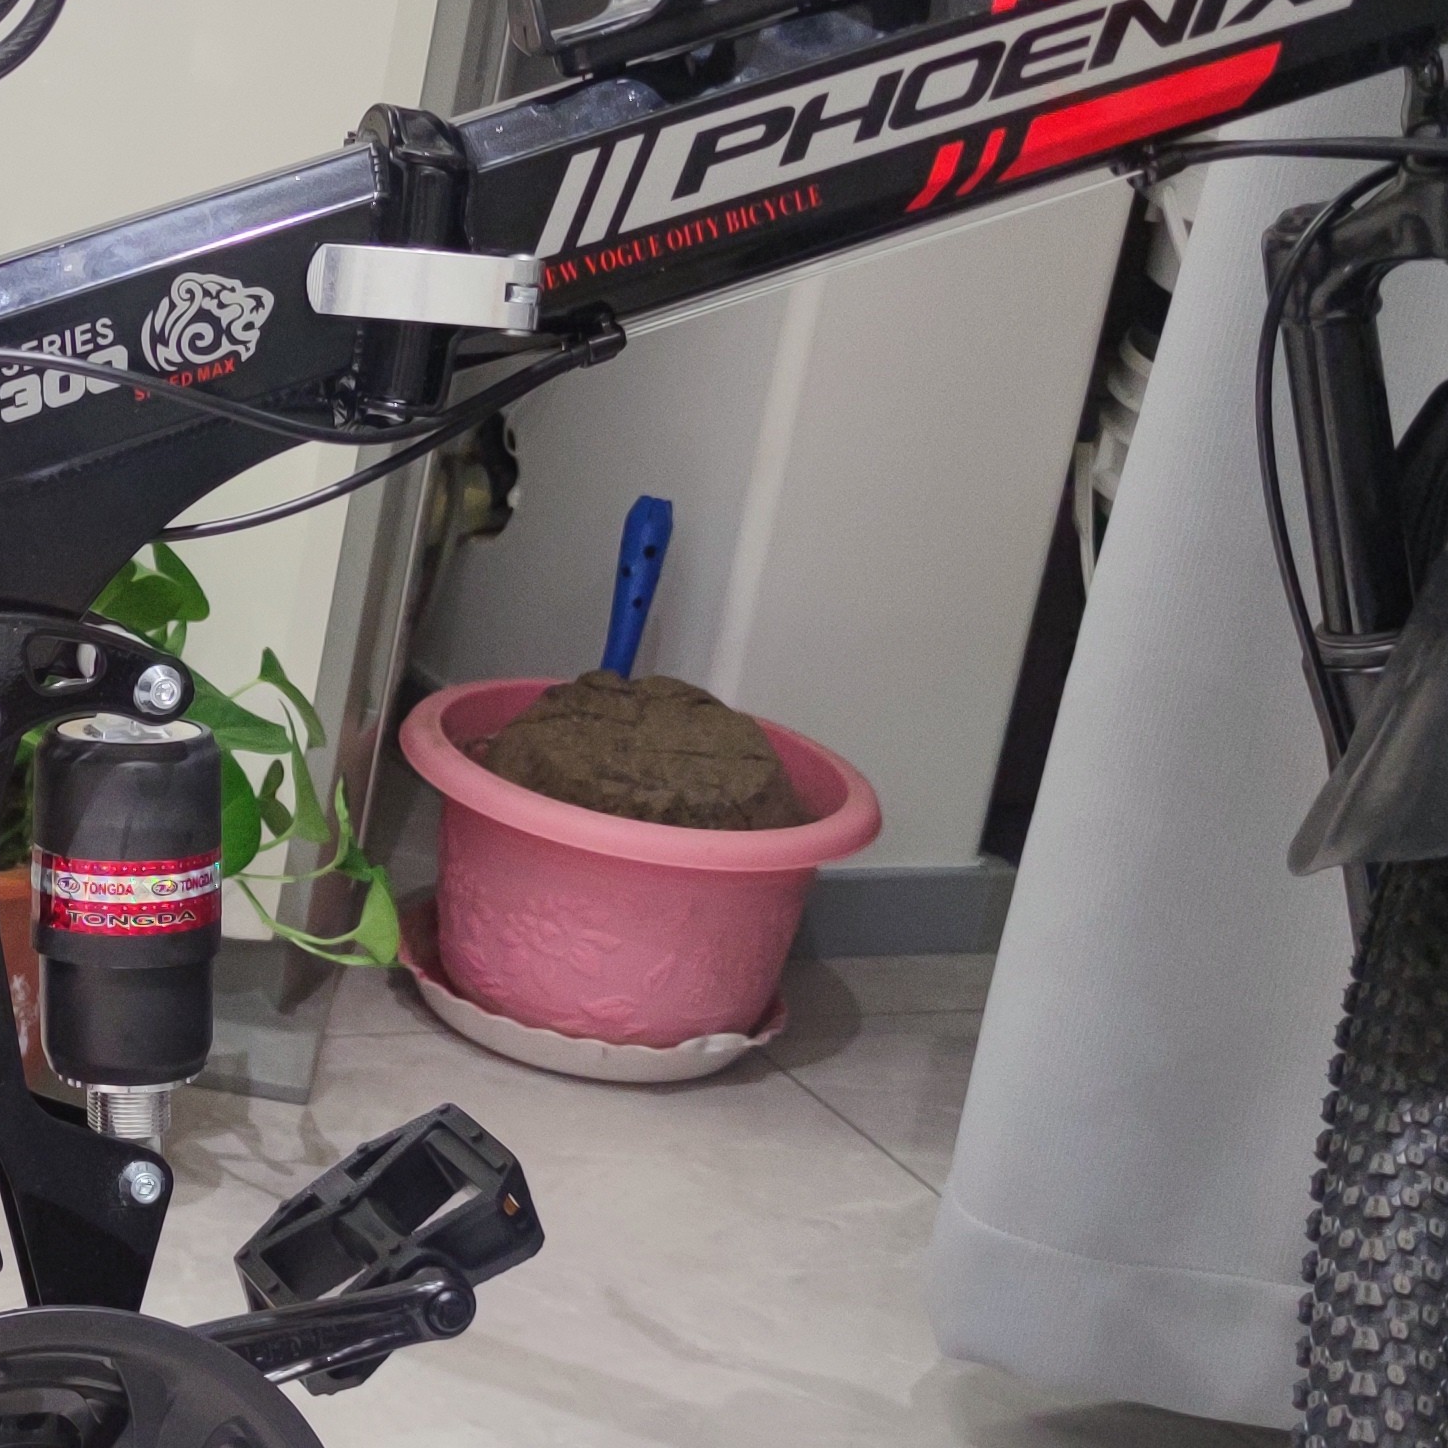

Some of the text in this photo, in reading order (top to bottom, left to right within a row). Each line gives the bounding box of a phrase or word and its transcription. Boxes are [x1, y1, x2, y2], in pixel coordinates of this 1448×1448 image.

[540, 261, 578, 291] EW
[584, 235, 663, 276] VOGUE
[724, 183, 822, 234] BICYCLE
[197, 357, 235, 383] MAX
[0, 344, 129, 423] 300
[82, 882, 135, 896] TONGDA
[66, 910, 197, 928] TONGDA
